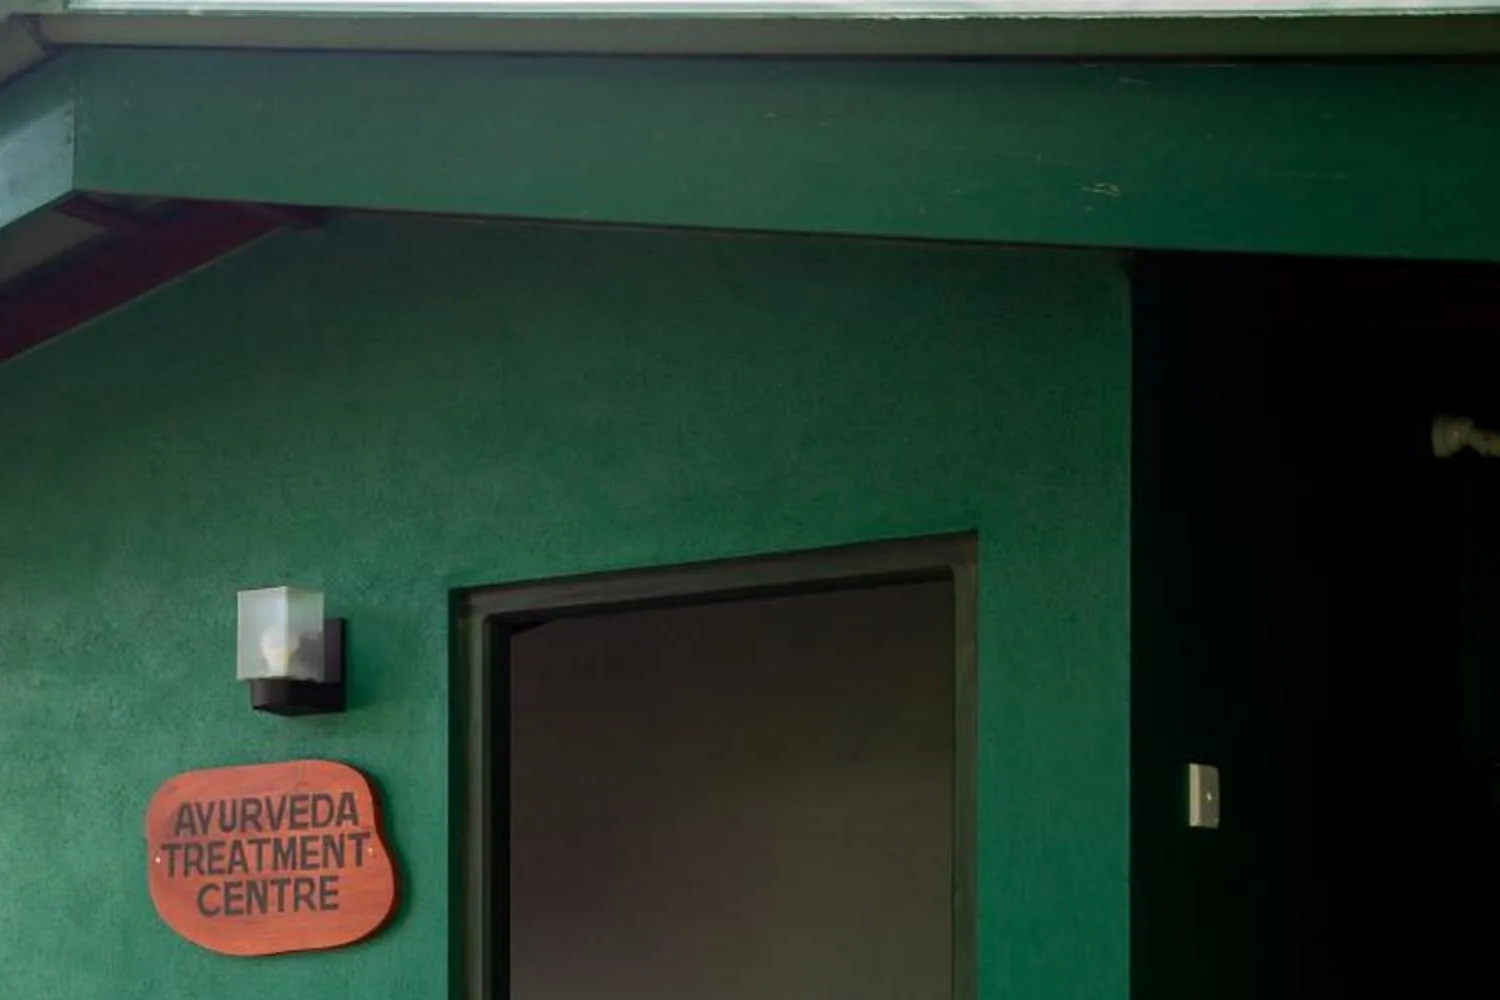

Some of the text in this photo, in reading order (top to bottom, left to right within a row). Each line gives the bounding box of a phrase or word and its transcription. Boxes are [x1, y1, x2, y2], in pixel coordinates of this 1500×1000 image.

[175, 792, 359, 836] AYURVEDA
[161, 831, 370, 877] TREATMENT
[196, 875, 340, 917] CENTRE
